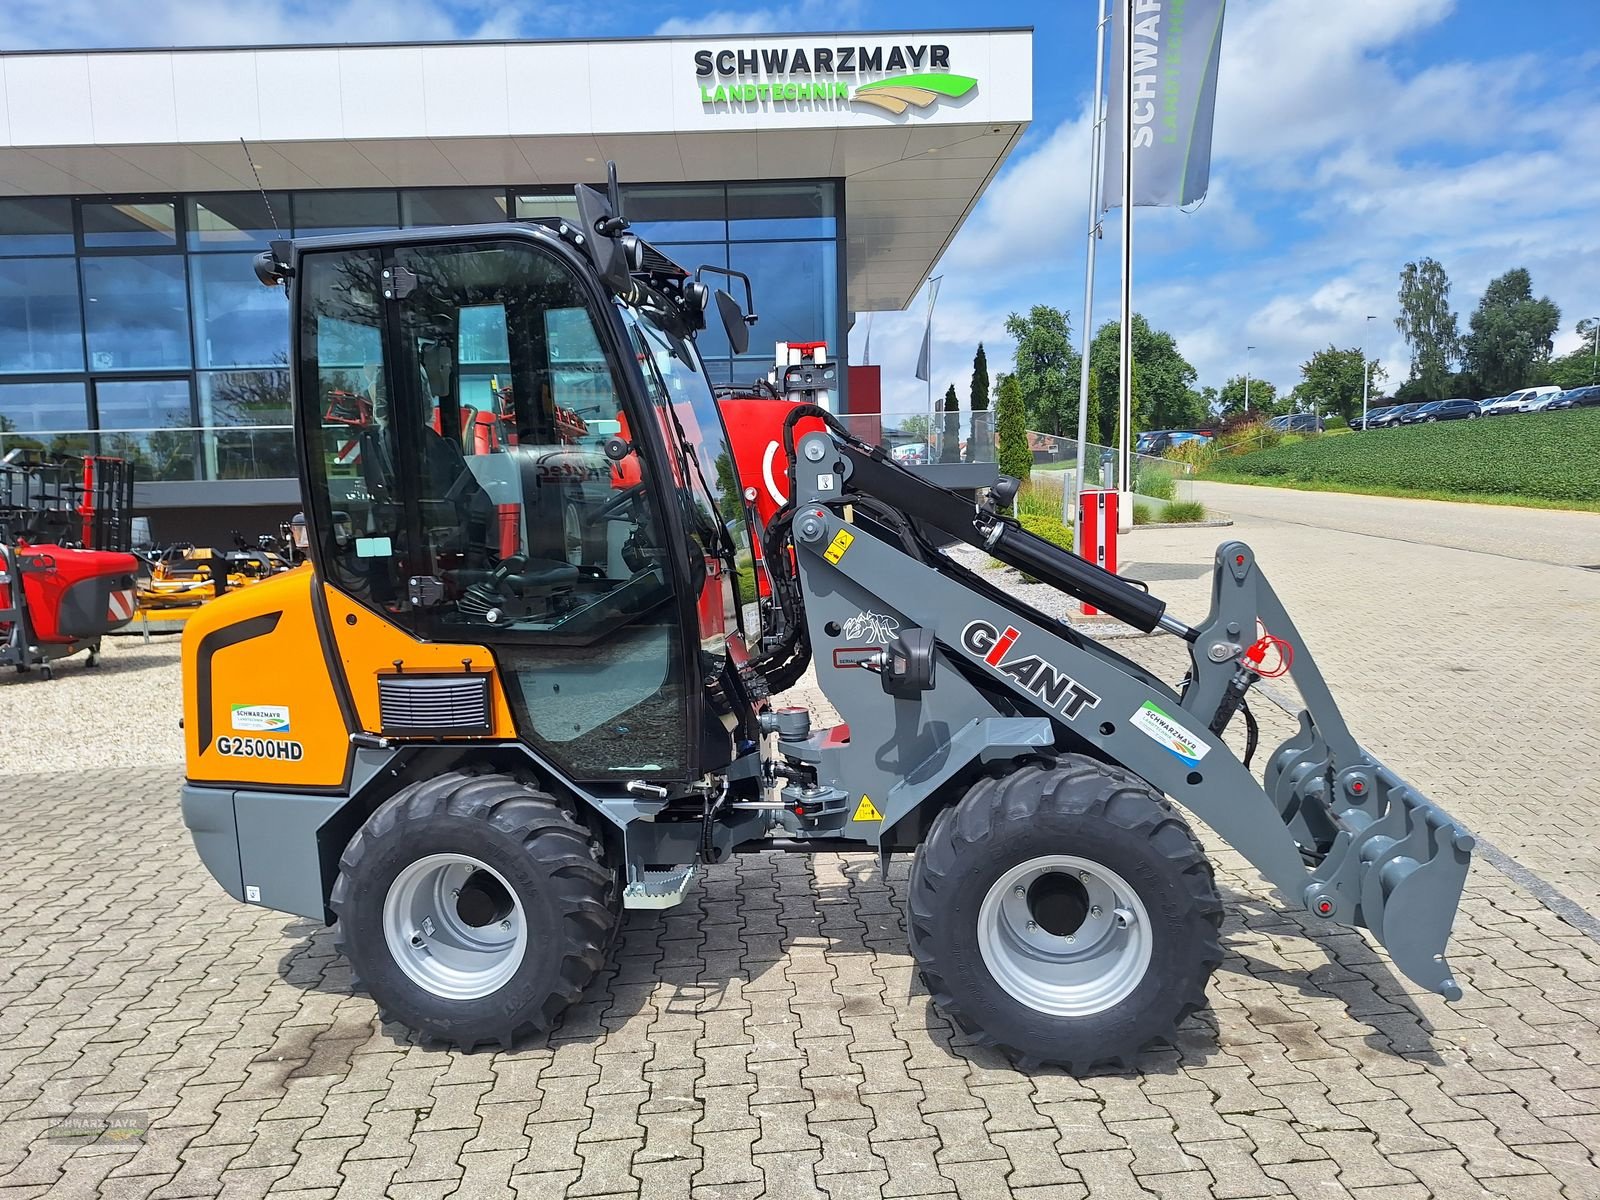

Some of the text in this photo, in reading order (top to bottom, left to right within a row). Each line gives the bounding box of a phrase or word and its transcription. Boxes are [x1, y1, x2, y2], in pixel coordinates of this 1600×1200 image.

[694, 45, 950, 76] SCHWARZMAYR
[701, 81, 849, 103] LANDTECHNIK
[236, 710, 281, 718] SCHWARZMAYR
[1145, 710, 1197, 750] SCHWARZMAYR
[217, 736, 303, 761] G2500HD
